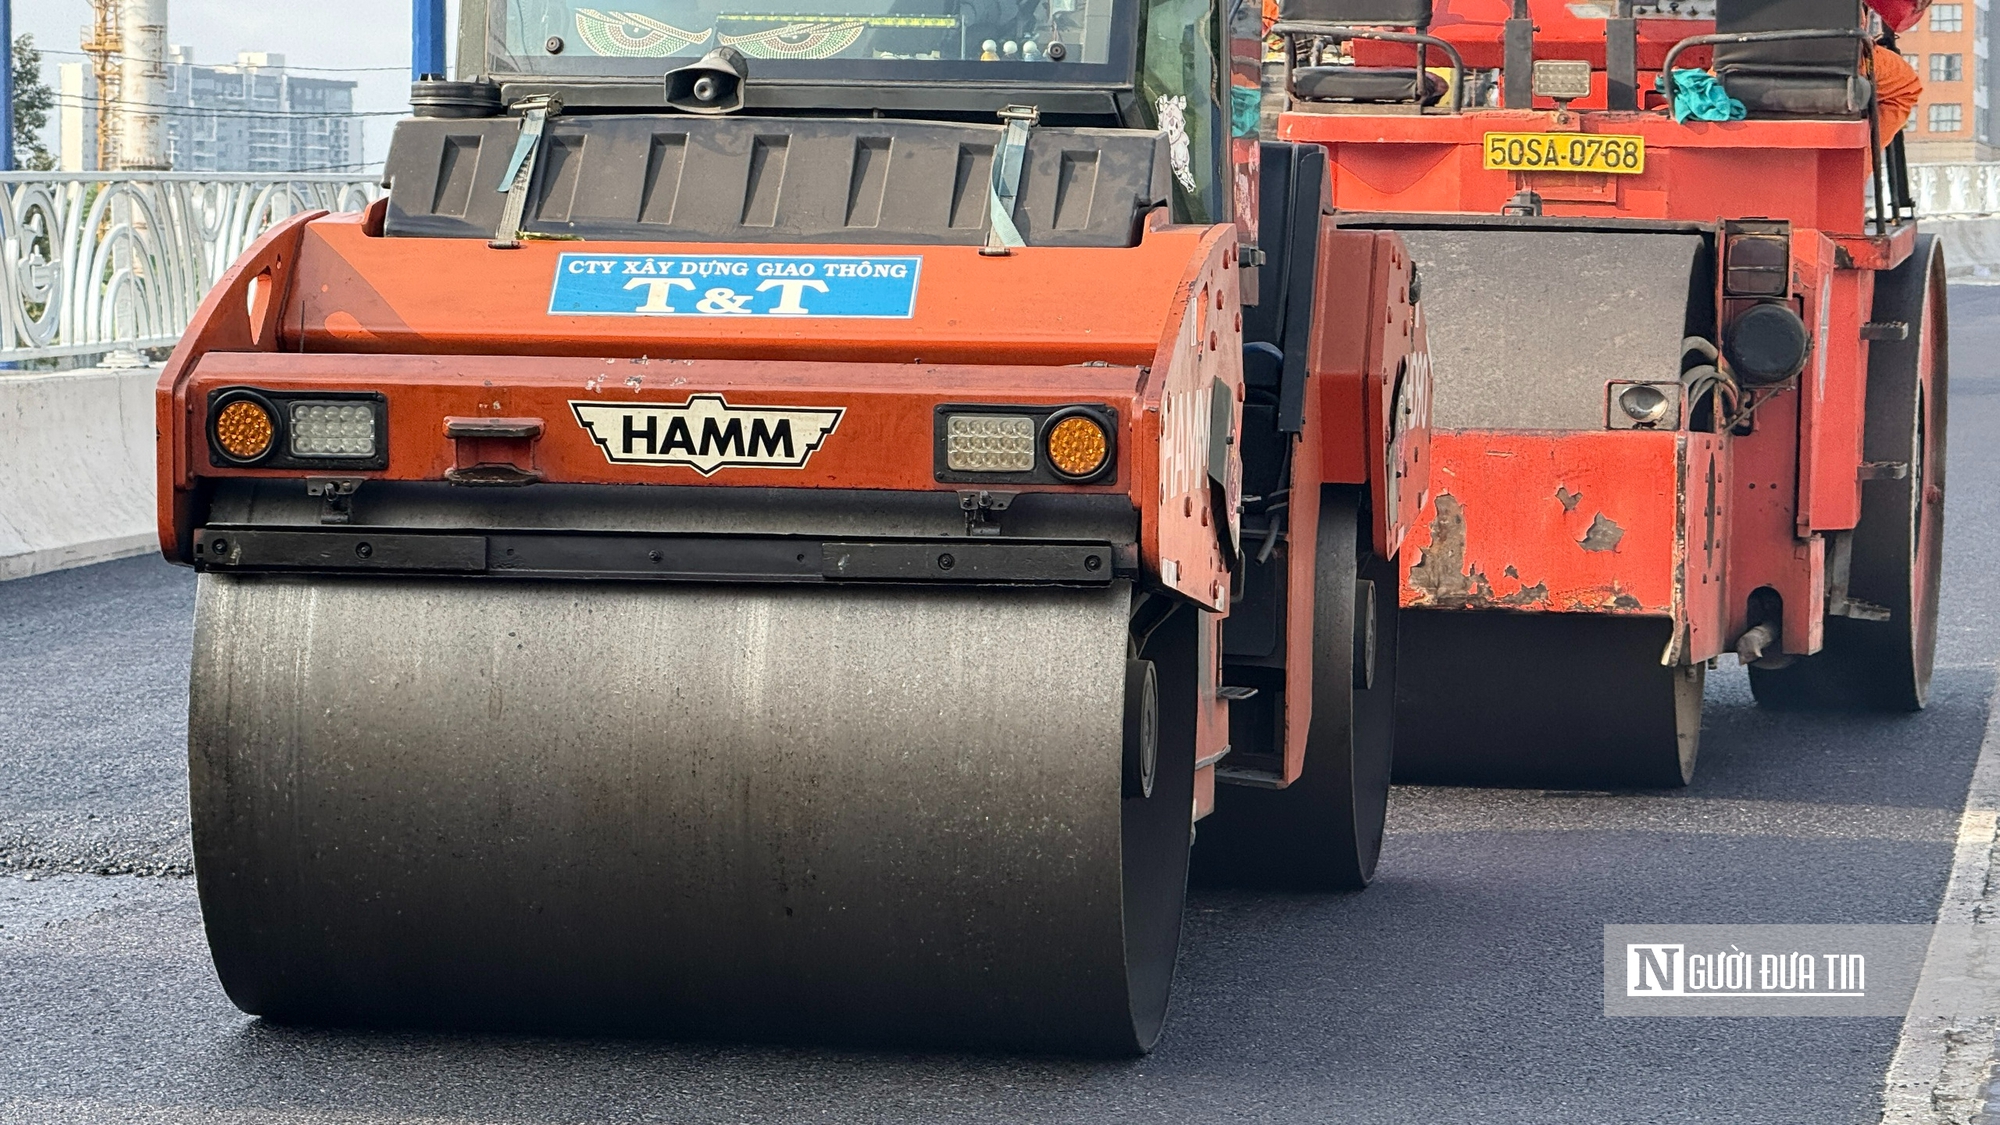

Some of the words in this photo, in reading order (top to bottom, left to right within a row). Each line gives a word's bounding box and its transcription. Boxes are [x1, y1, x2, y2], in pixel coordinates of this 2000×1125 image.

[1490, 137, 1638, 169] 50SA-0768
[568, 260, 616, 275] CTY
[622, 257, 675, 275] XÂY
[679, 259, 750, 278] DỰNG
[756, 262, 815, 277] GIAO
[823, 260, 908, 278] THÔNG
[622, 414, 795, 458] HAMM
